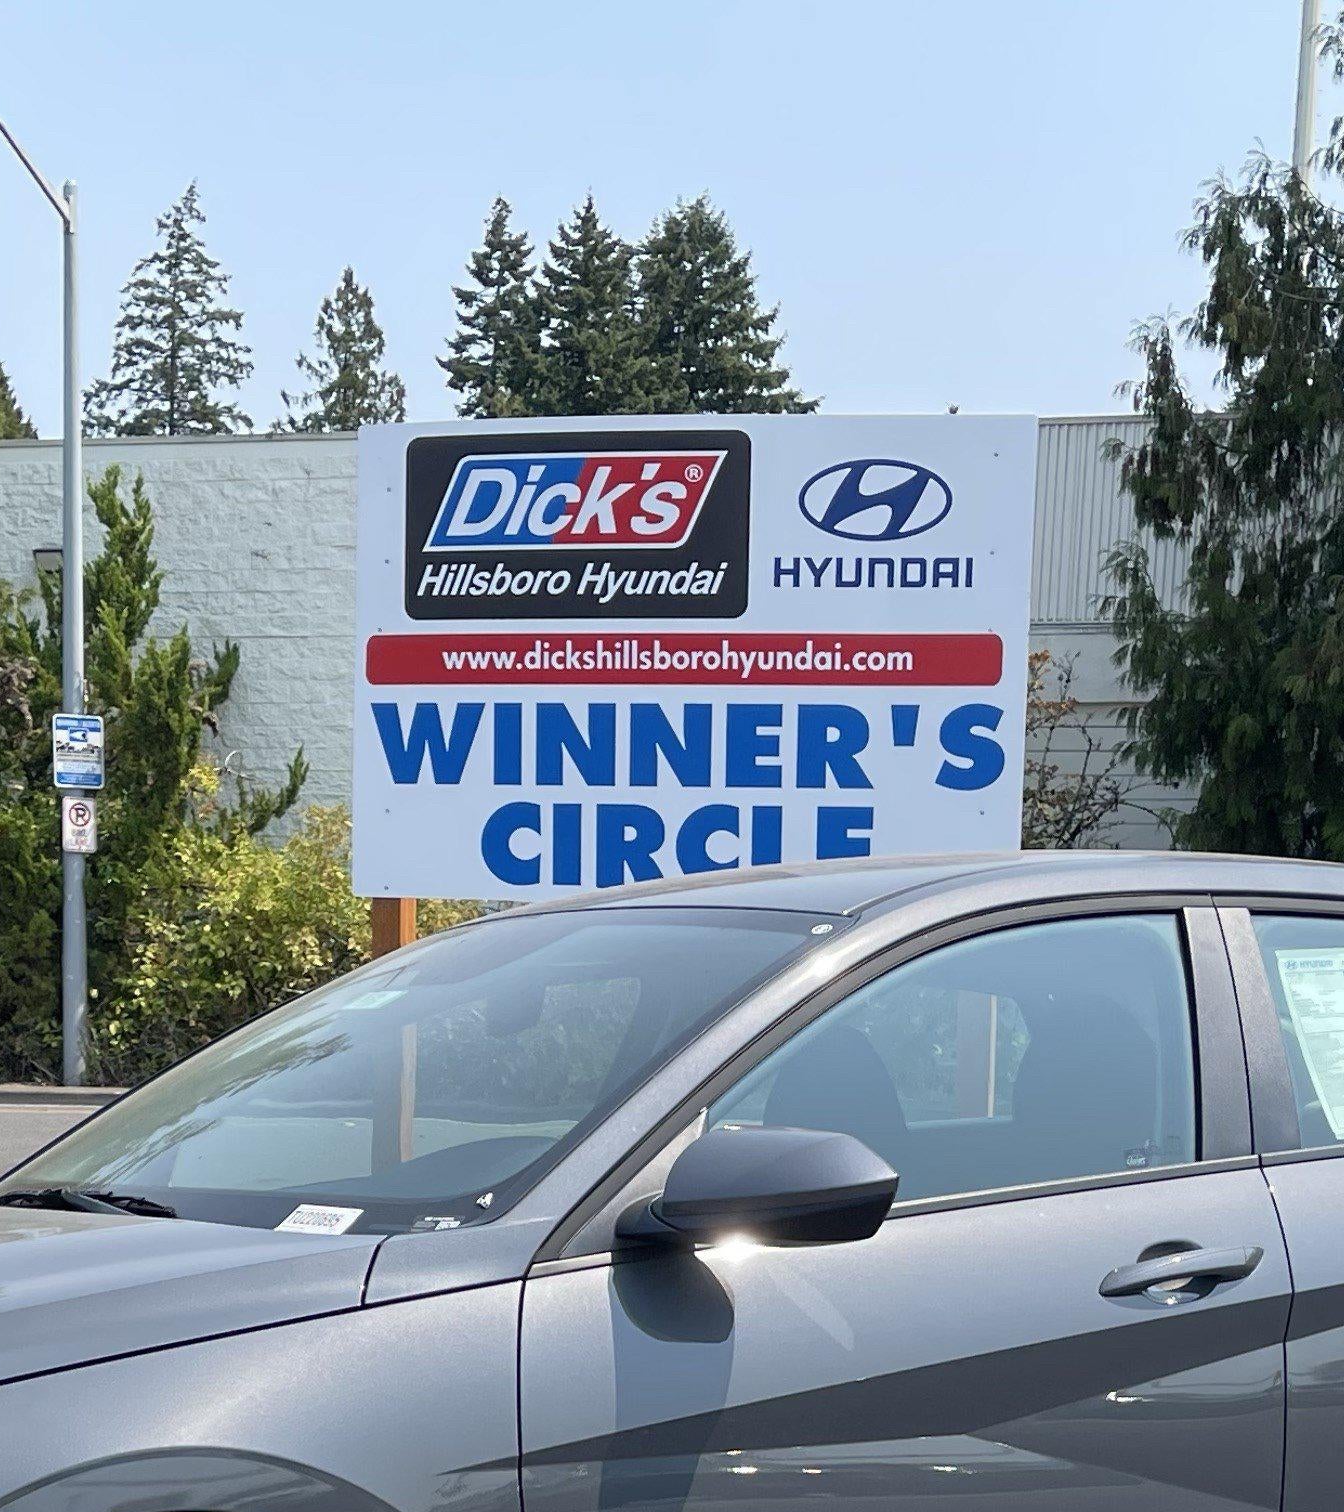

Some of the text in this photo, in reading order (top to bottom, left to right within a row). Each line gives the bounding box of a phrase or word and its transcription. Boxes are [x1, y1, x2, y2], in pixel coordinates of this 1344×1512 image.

[446, 463, 688, 537] Dick's
[416, 561, 729, 604] Hillsboro Hyundai
[773, 556, 974, 589] HYUNDAI
[442, 638, 914, 676] www.dickshillsborohyundai.com
[370, 702, 1006, 792] WINNER'S
